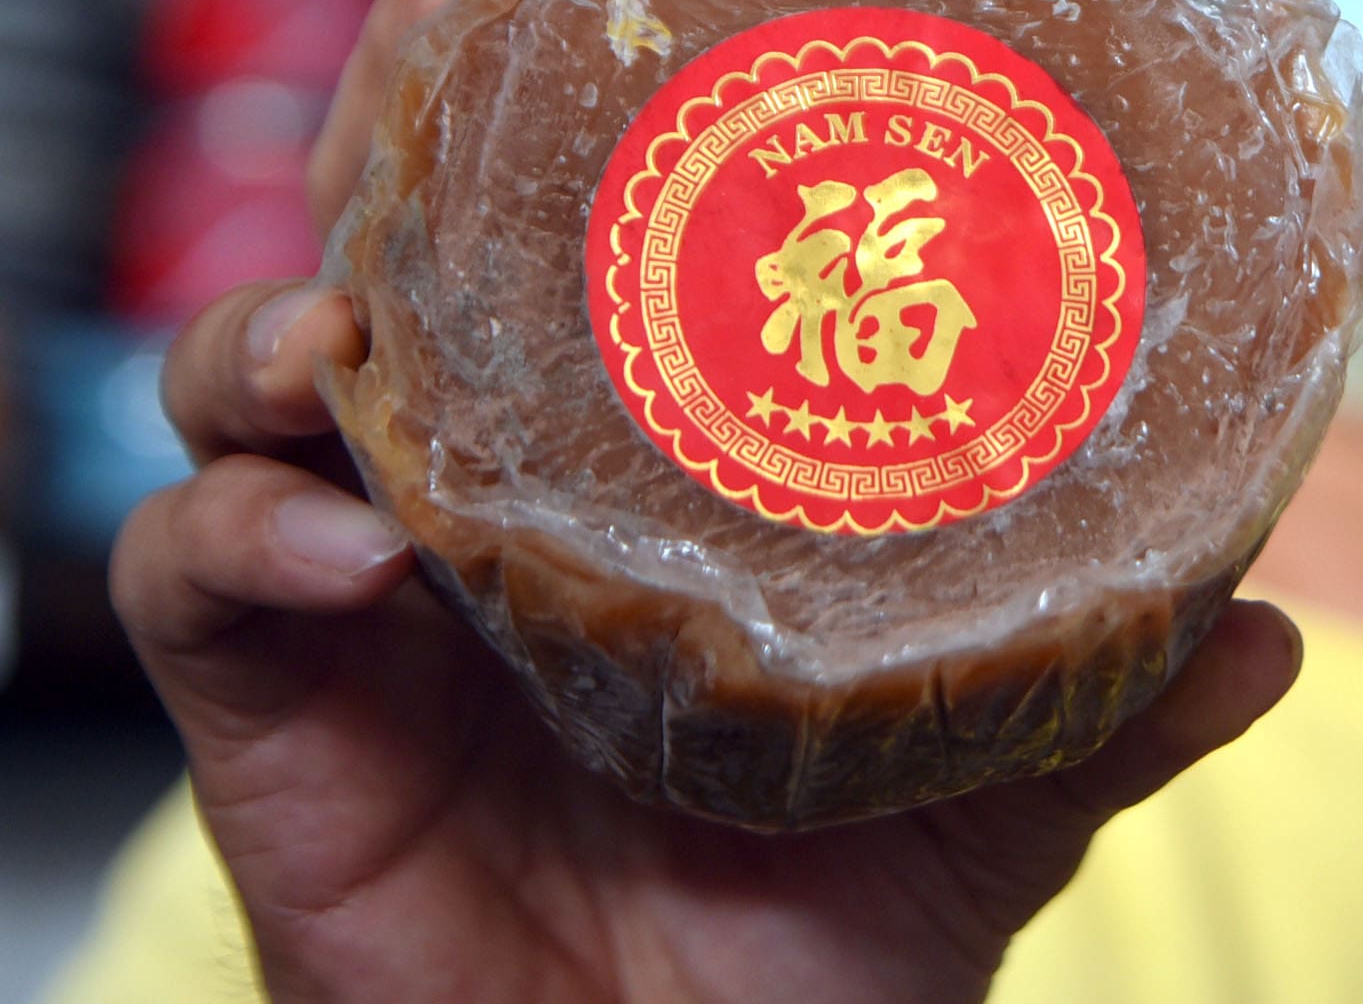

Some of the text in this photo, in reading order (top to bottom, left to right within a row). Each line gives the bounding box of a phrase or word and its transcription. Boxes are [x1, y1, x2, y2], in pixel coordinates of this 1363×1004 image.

[749, 112, 990, 178] NAM SEN
[754, 167, 978, 396] 福
